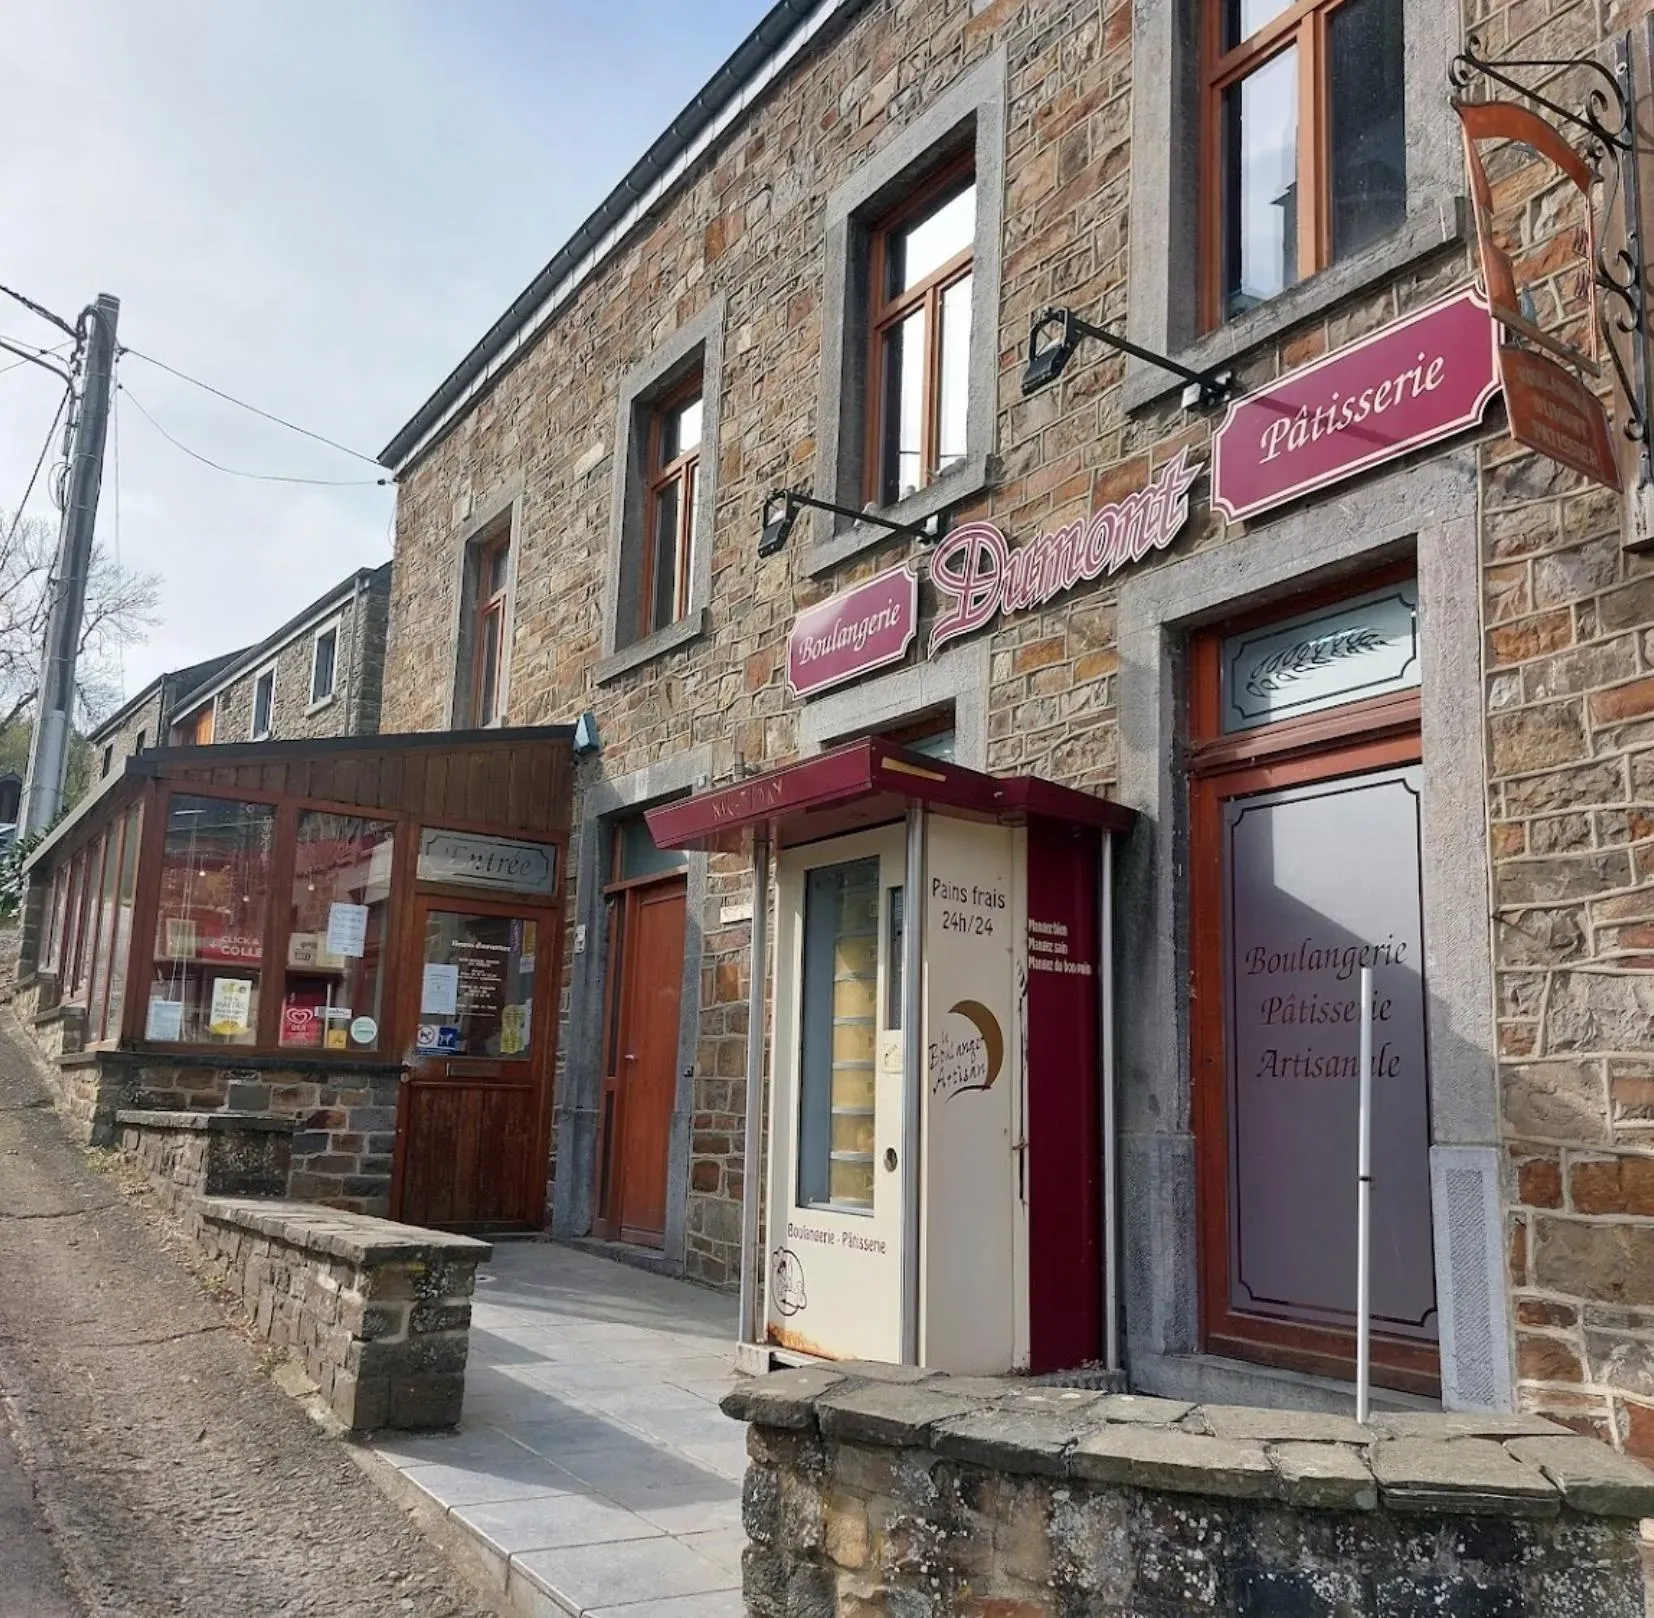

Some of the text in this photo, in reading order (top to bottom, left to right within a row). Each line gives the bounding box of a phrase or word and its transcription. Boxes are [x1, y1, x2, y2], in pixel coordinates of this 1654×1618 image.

[1258, 352, 1444, 464] Pâtisserie
[928, 444, 1205, 661] Dumont
[799, 598, 900, 666] Boulangerie
[444, 845, 533, 877] Entrée
[931, 877, 1006, 909] Pains frais
[942, 911, 994, 936] 24h/24
[220, 936, 250, 945] CLICK
[220, 945, 263, 957] COLLE
[1245, 934, 1407, 980] Boulangerie
[1259, 990, 1392, 1026] Pâtisseie
[933, 1063, 986, 1094] Artisan
[787, 1223, 835, 1245] Boulangerie
[841, 1231, 887, 1254] Pâtisserie
